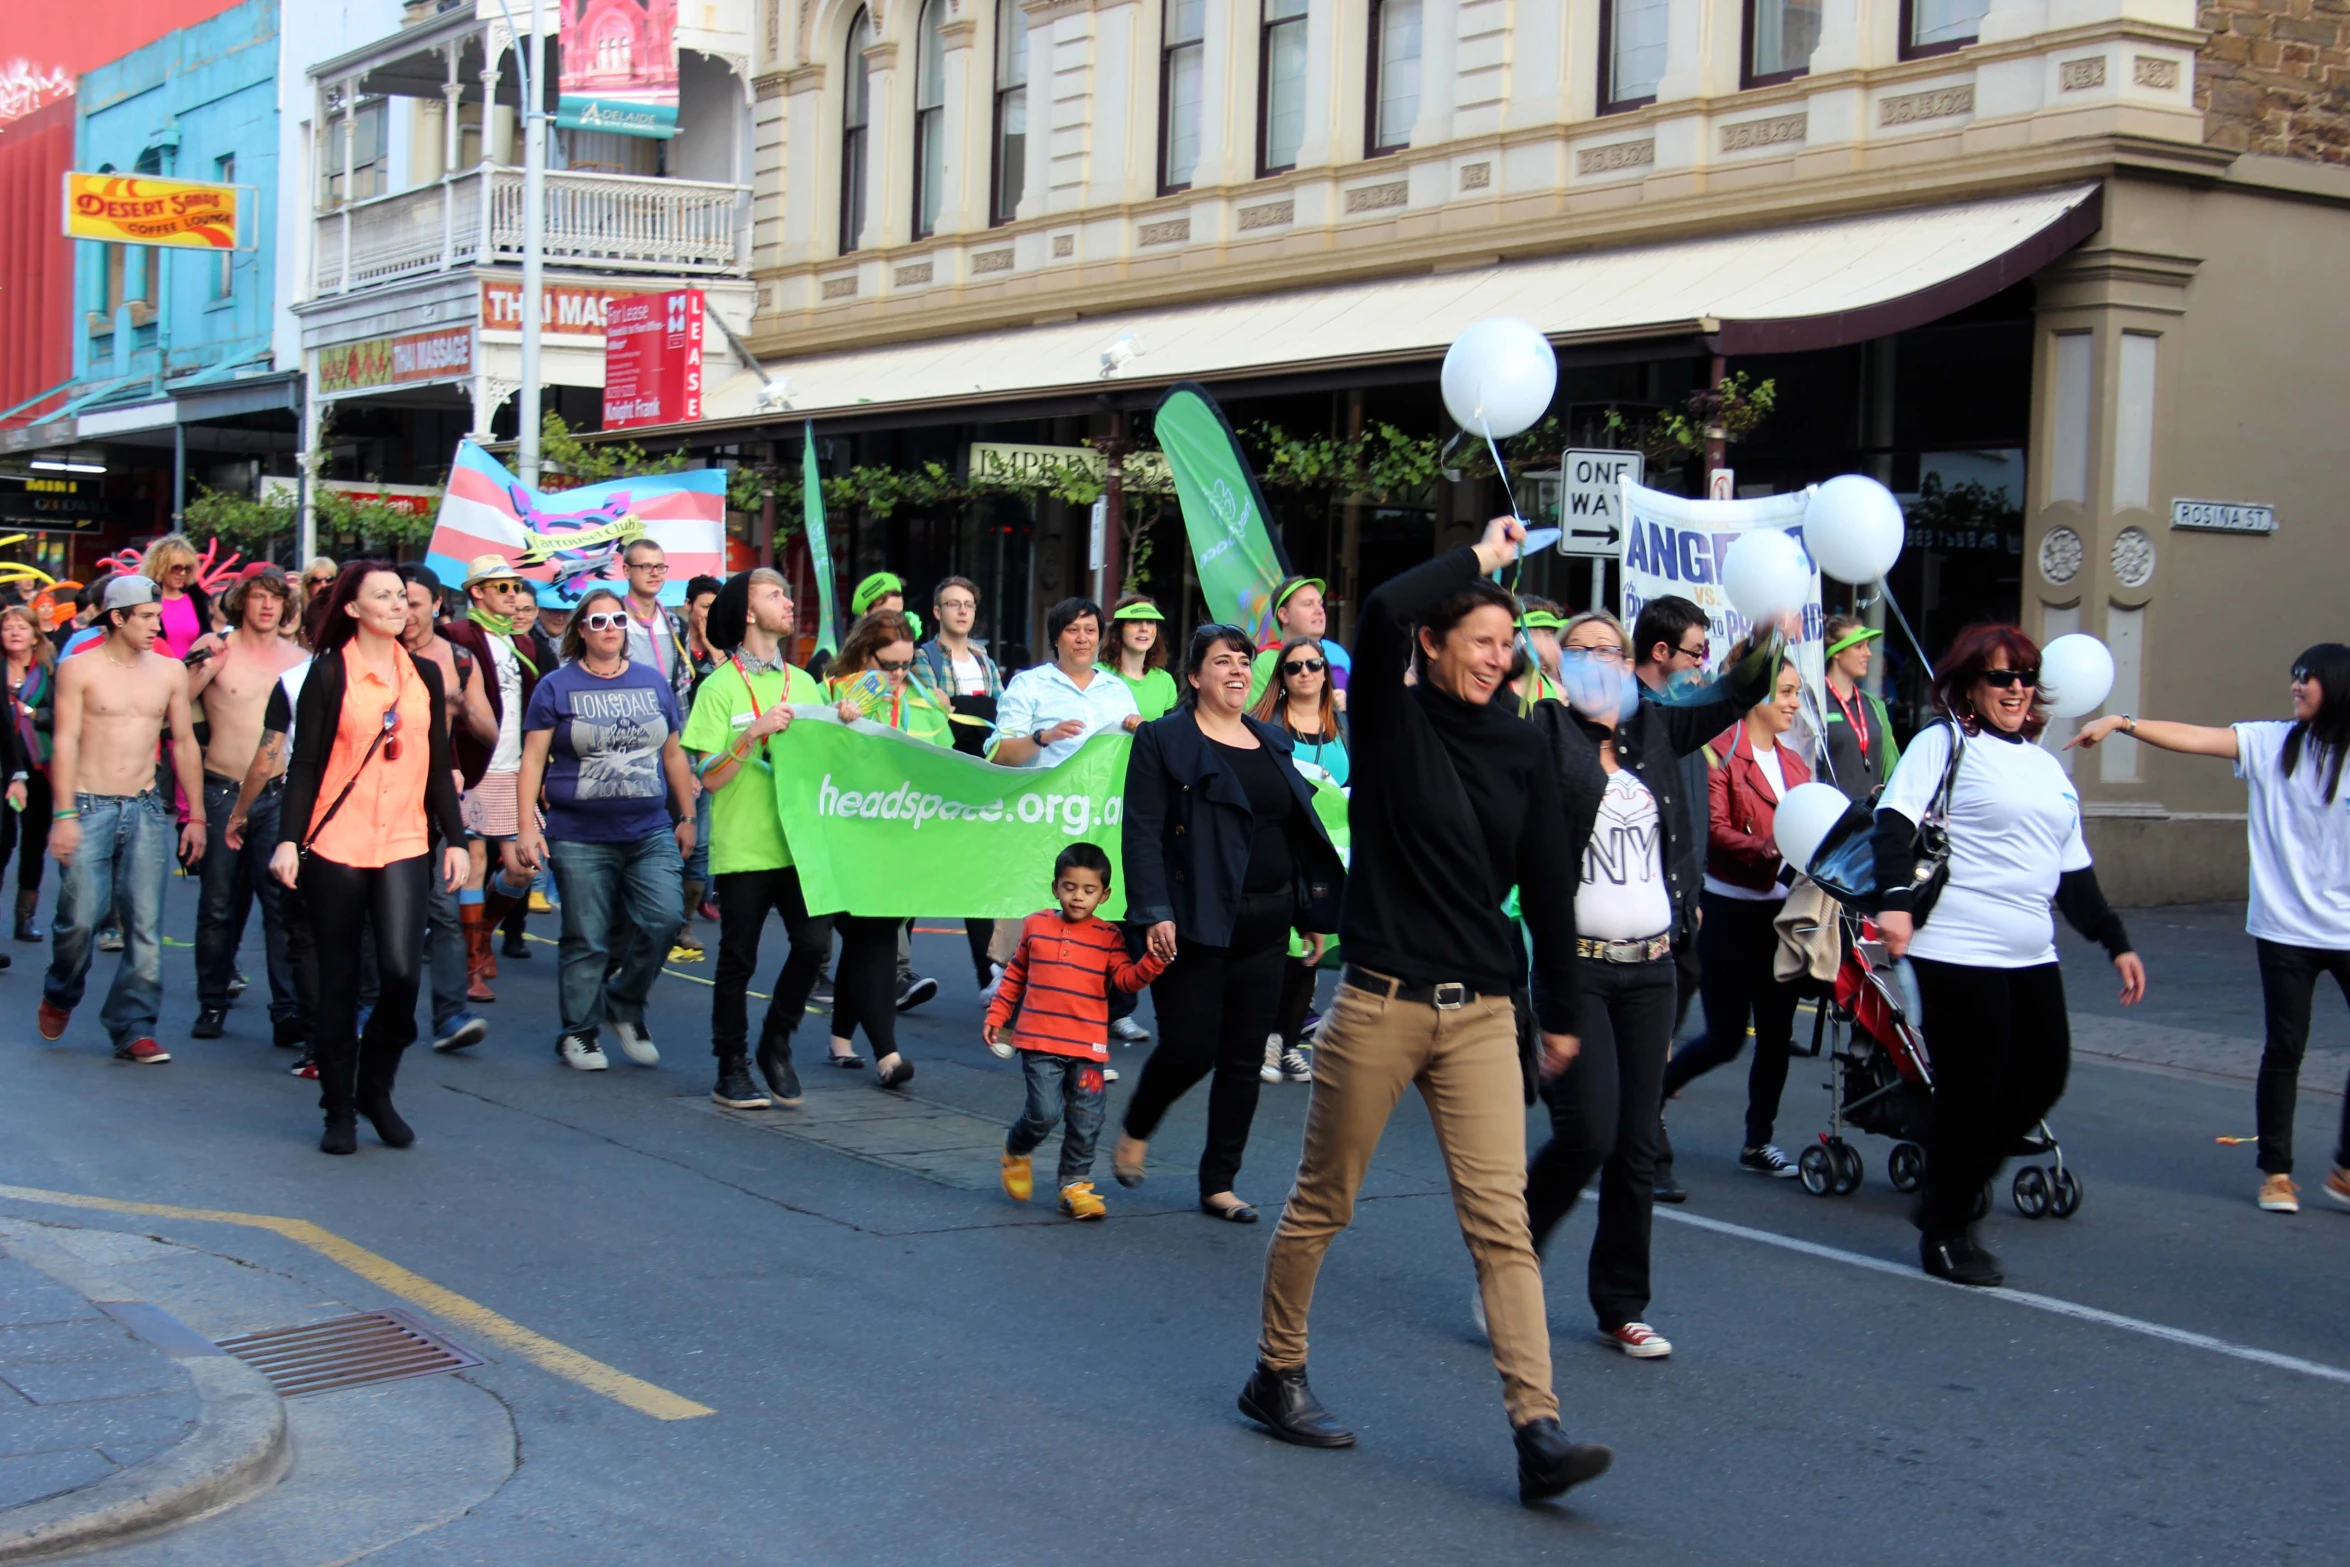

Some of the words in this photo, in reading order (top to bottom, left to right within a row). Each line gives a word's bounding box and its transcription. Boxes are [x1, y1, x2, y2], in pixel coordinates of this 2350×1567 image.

[77, 194, 164, 218] DESERT
[128, 222, 177, 234] COFFEE
[184, 213, 231, 228] LOUNGE
[489, 291, 552, 323] THI
[394, 343, 416, 373] THAI
[417, 335, 469, 370] MASSAGE
[686, 296, 702, 416] LEASE
[605, 400, 634, 425] Knight
[635, 397, 661, 418] Frank
[25, 480, 77, 493] MINI
[1577, 461, 1628, 485] ONE
[605, 517, 637, 537] Club
[2181, 505, 2240, 525] ROSINA
[574, 692, 661, 719] LONSDALE
[819, 773, 1122, 835] headspace.org.a
[1580, 822, 1659, 885] NY
